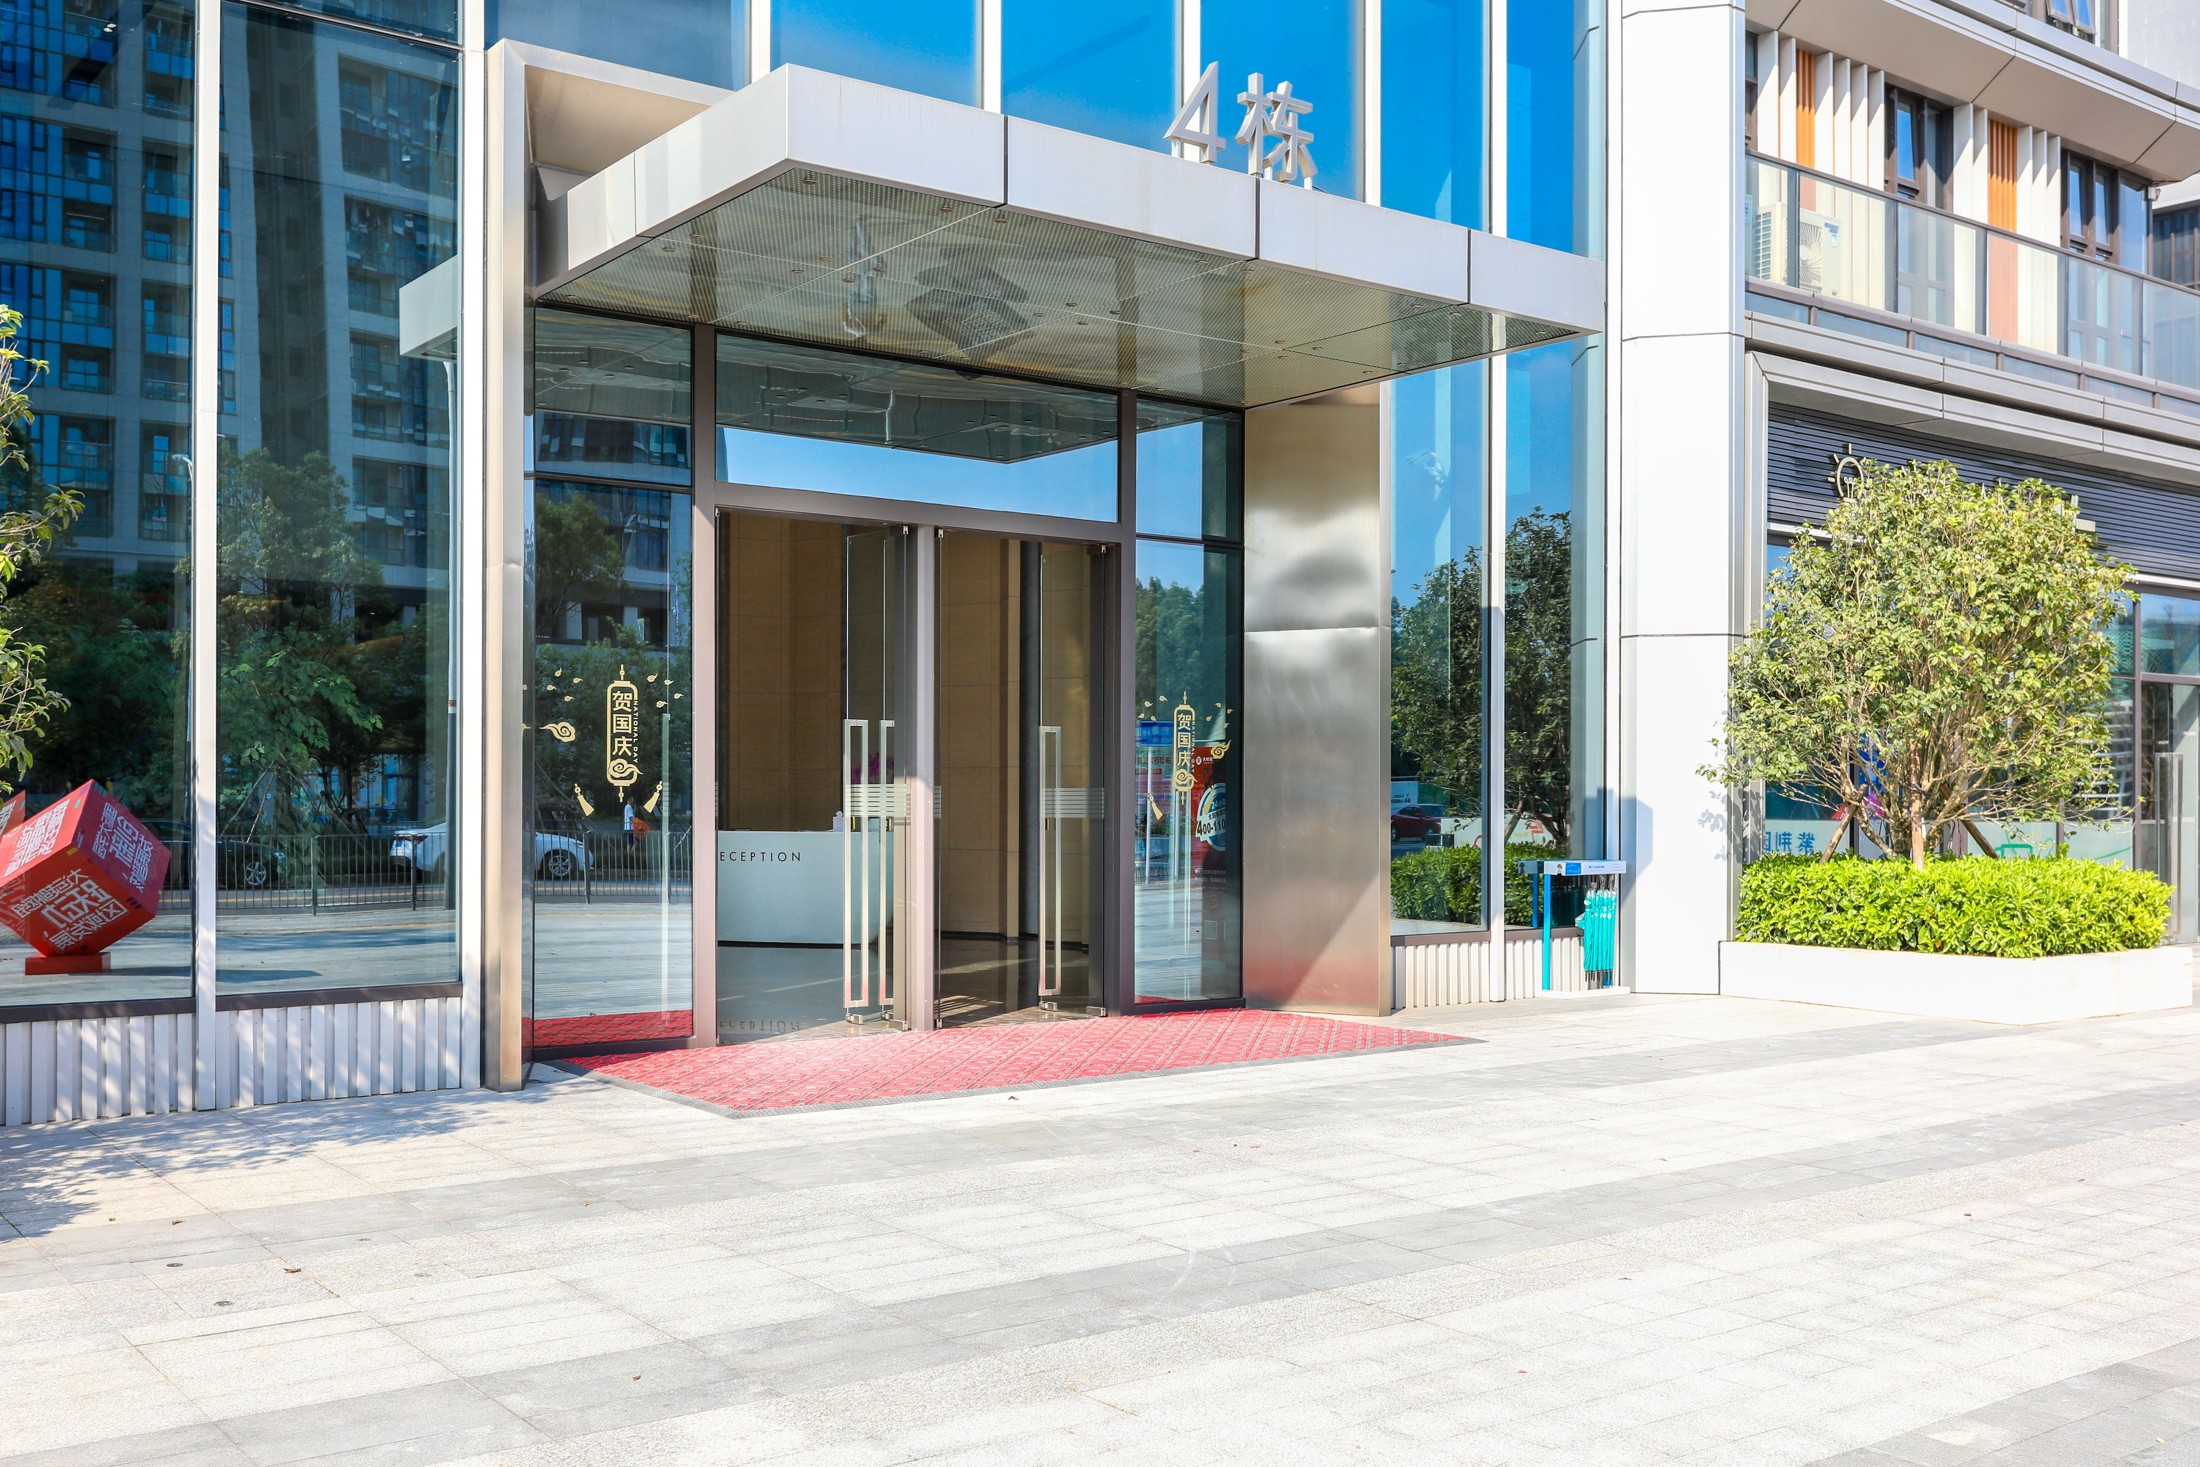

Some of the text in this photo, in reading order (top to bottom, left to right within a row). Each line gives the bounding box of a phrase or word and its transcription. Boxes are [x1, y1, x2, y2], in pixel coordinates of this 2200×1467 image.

[1163, 61, 1318, 182] 4栋
[612, 691, 632, 756] 贺国庆
[1177, 713, 1191, 766] 贺国庆
